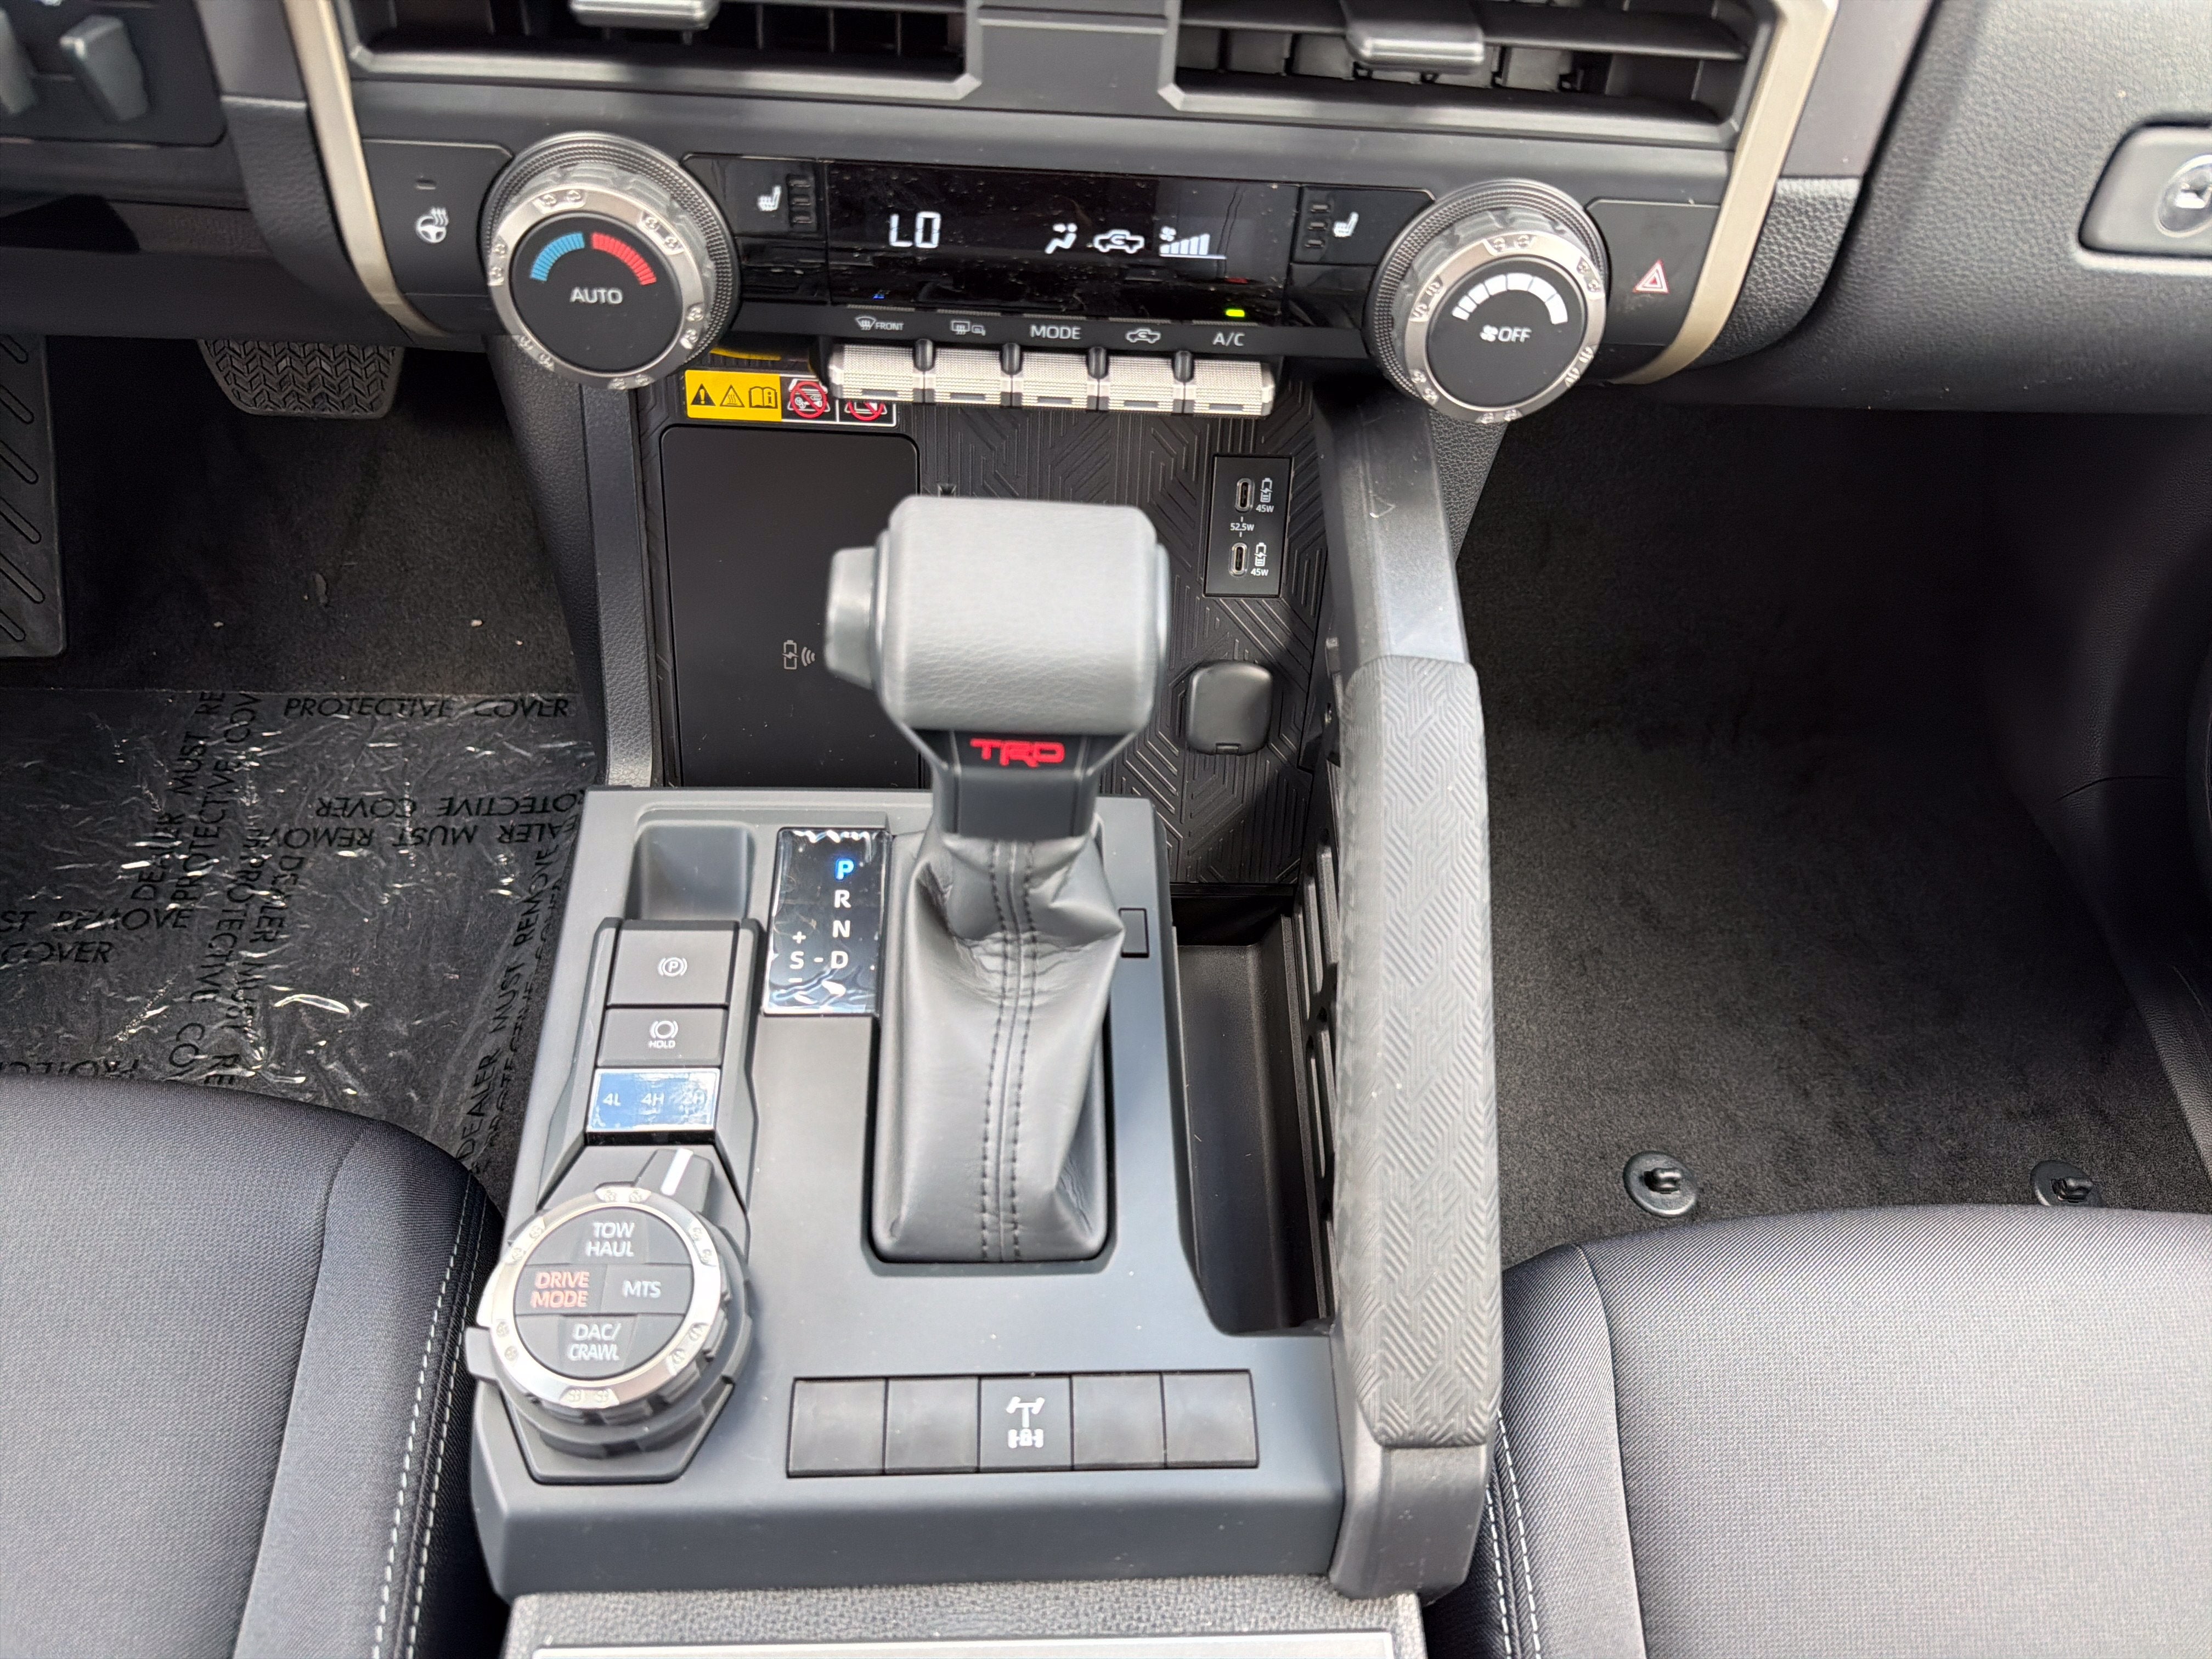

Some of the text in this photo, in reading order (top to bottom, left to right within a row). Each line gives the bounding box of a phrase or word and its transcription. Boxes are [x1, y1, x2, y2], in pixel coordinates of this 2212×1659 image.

[569, 286, 624, 305] AUTO
[874, 321, 904, 331] FRONT
[1030, 325, 1081, 341] MODE
[1498, 326, 1532, 343] OFF
[1212, 332, 1245, 348] A/C
[1255, 504, 1274, 513] 45W
[1230, 522, 1255, 531] 52.5W
[1250, 568, 1269, 576] 45W
[284, 697, 569, 718] PROTECTIVE COVER
[969, 738, 1065, 768] TRD
[167, 731, 210, 795] MUST
[315, 797, 416, 819] COVER
[392, 825, 477, 847] MUST
[834, 858, 855, 880] P
[833, 889, 851, 908] R
[832, 919, 851, 938] N
[2, 941, 113, 963] COVER
[789, 950, 849, 969] S D
[648, 1040, 676, 1048] HOLD
[456, 1048, 500, 1160] DEALER
[489, 962, 526, 1034] MUST
[602, 1092, 621, 1107] 4L
[641, 1092, 665, 1106] 4H
[592, 1222, 635, 1238] TOW
[584, 1241, 635, 1257] HAUL
[534, 1271, 590, 1289] DRIVE
[623, 1280, 662, 1298] MTS
[530, 1290, 589, 1308] MODE
[572, 1323, 622, 1341] DAC/
[567, 1344, 620, 1361] CRAWL
